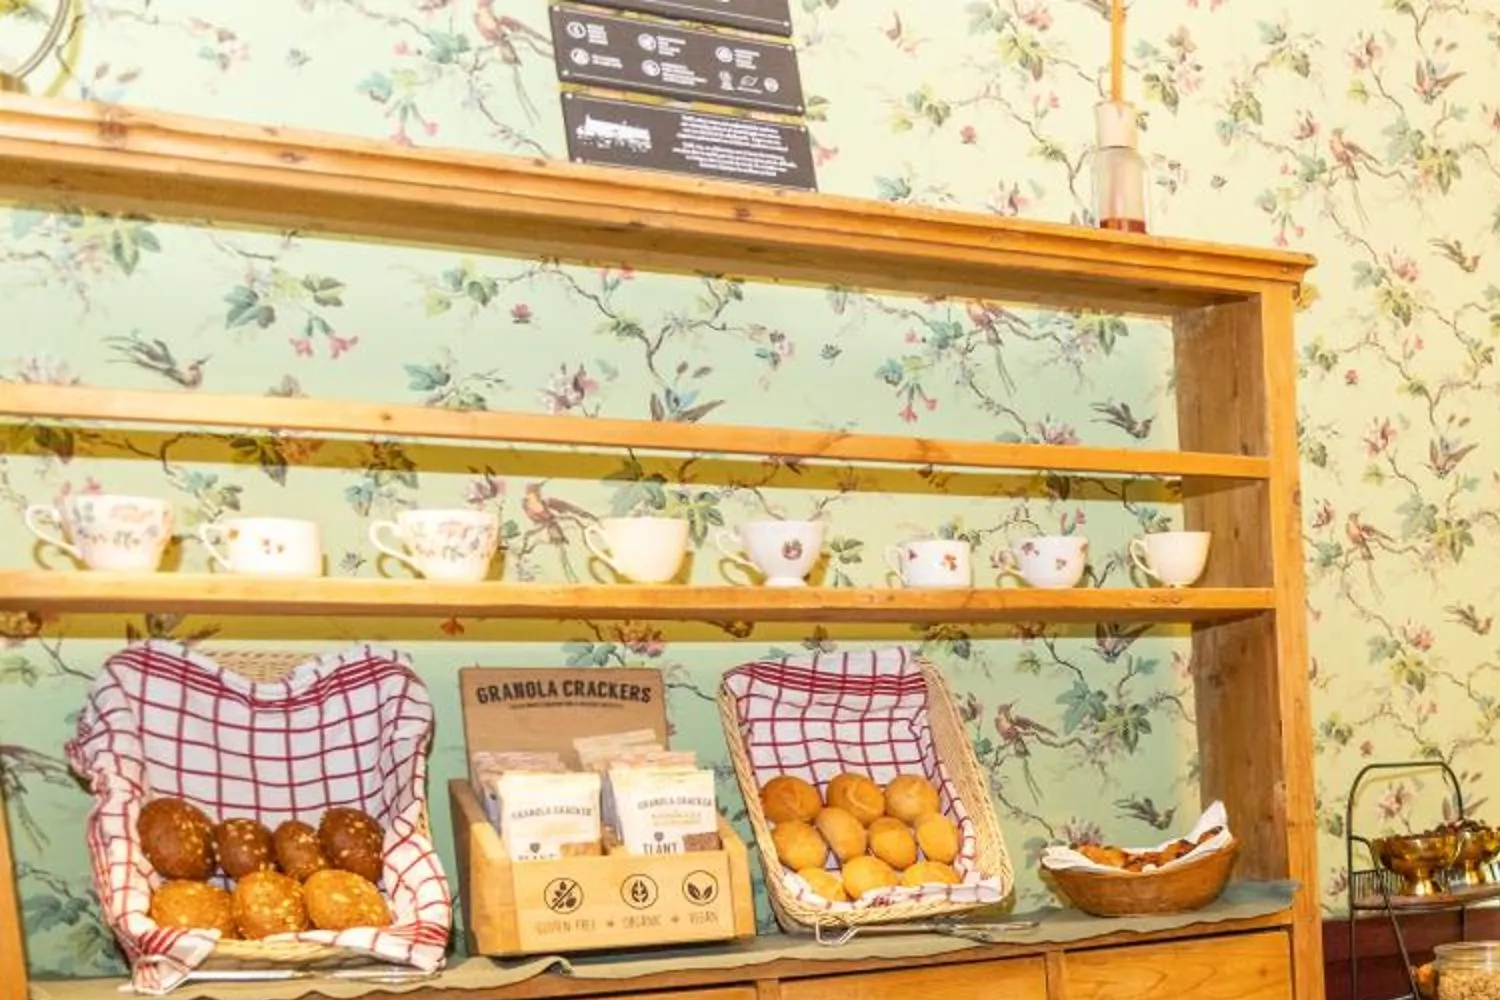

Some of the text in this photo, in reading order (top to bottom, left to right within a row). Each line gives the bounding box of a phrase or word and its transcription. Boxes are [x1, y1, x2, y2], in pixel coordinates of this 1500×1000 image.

[476, 680, 652, 704] GRANOLA CRACKERS
[688, 910, 719, 926] VEGAN
